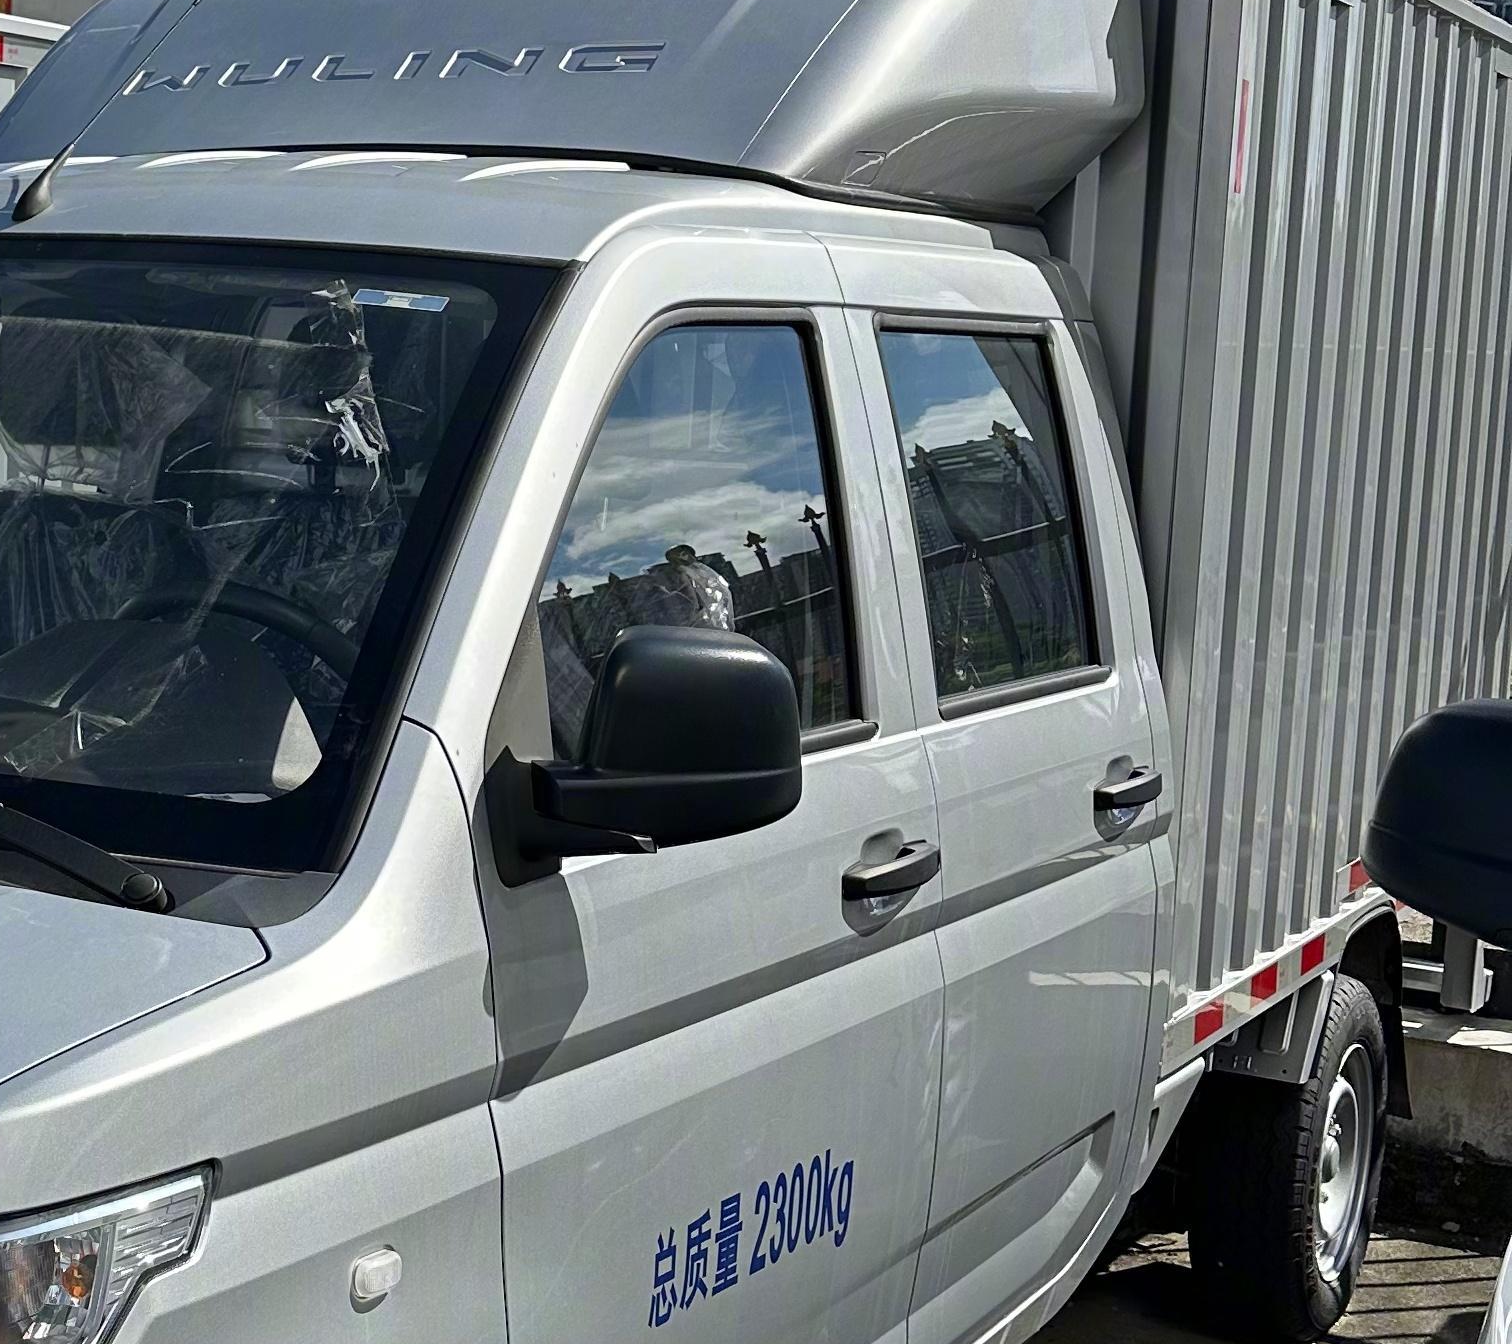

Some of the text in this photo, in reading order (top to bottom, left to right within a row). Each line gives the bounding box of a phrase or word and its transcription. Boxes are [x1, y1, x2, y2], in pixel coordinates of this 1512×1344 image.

[123, 41, 668, 95] WULING
[647, 1148, 854, 1328] 总质量 2300kg
